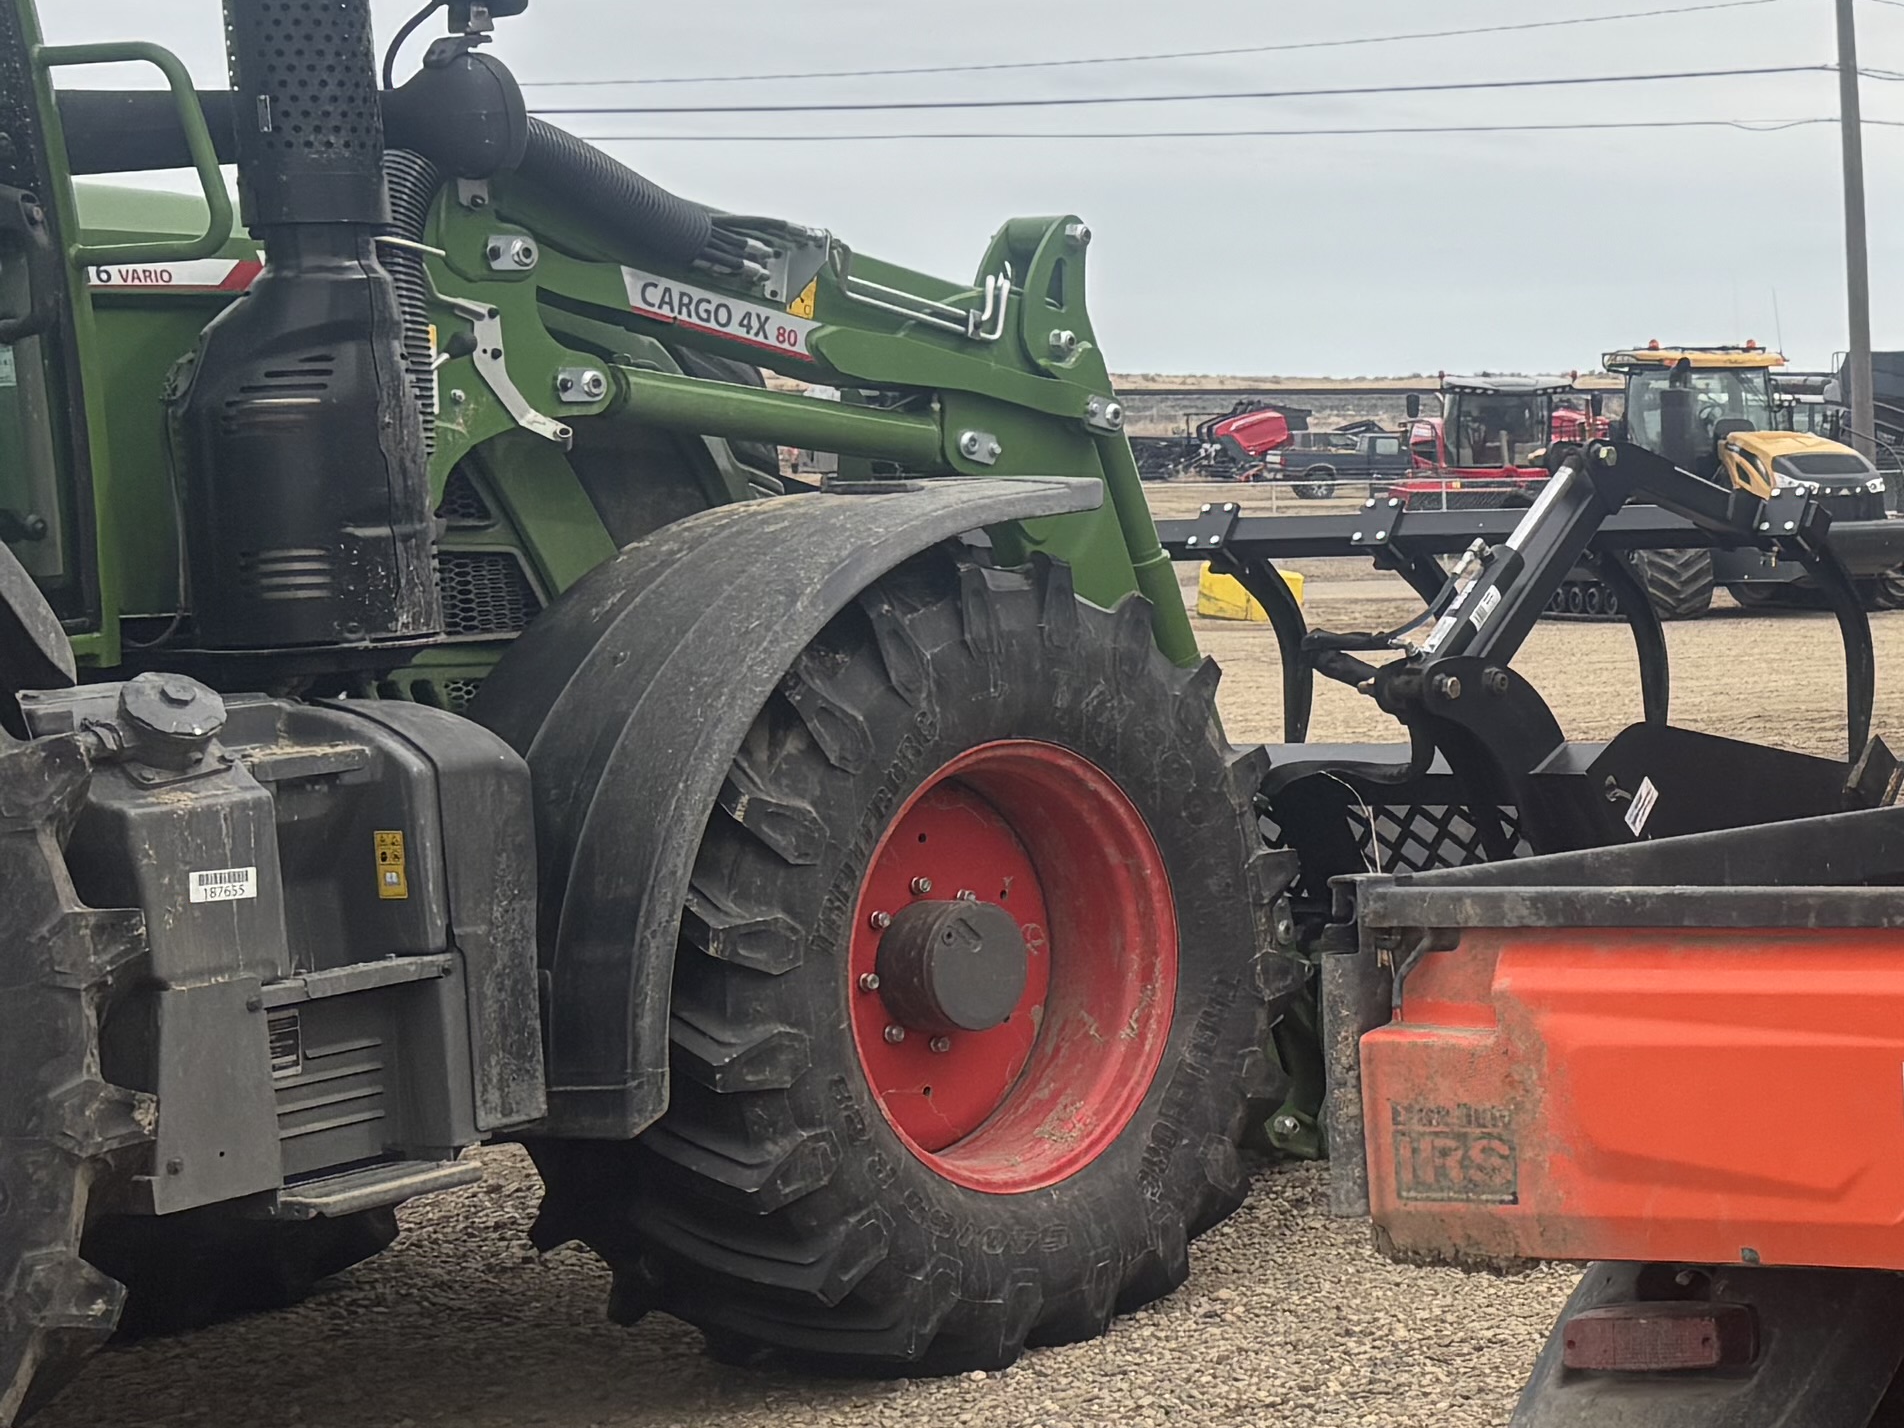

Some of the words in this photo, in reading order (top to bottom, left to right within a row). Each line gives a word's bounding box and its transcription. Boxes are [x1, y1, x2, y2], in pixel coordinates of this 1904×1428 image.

[117, 268, 173, 283] VARIO
[640, 281, 732, 329] CARGO
[738, 310, 771, 340] 4X
[775, 325, 798, 347] 80
[204, 883, 246, 902] 187655
